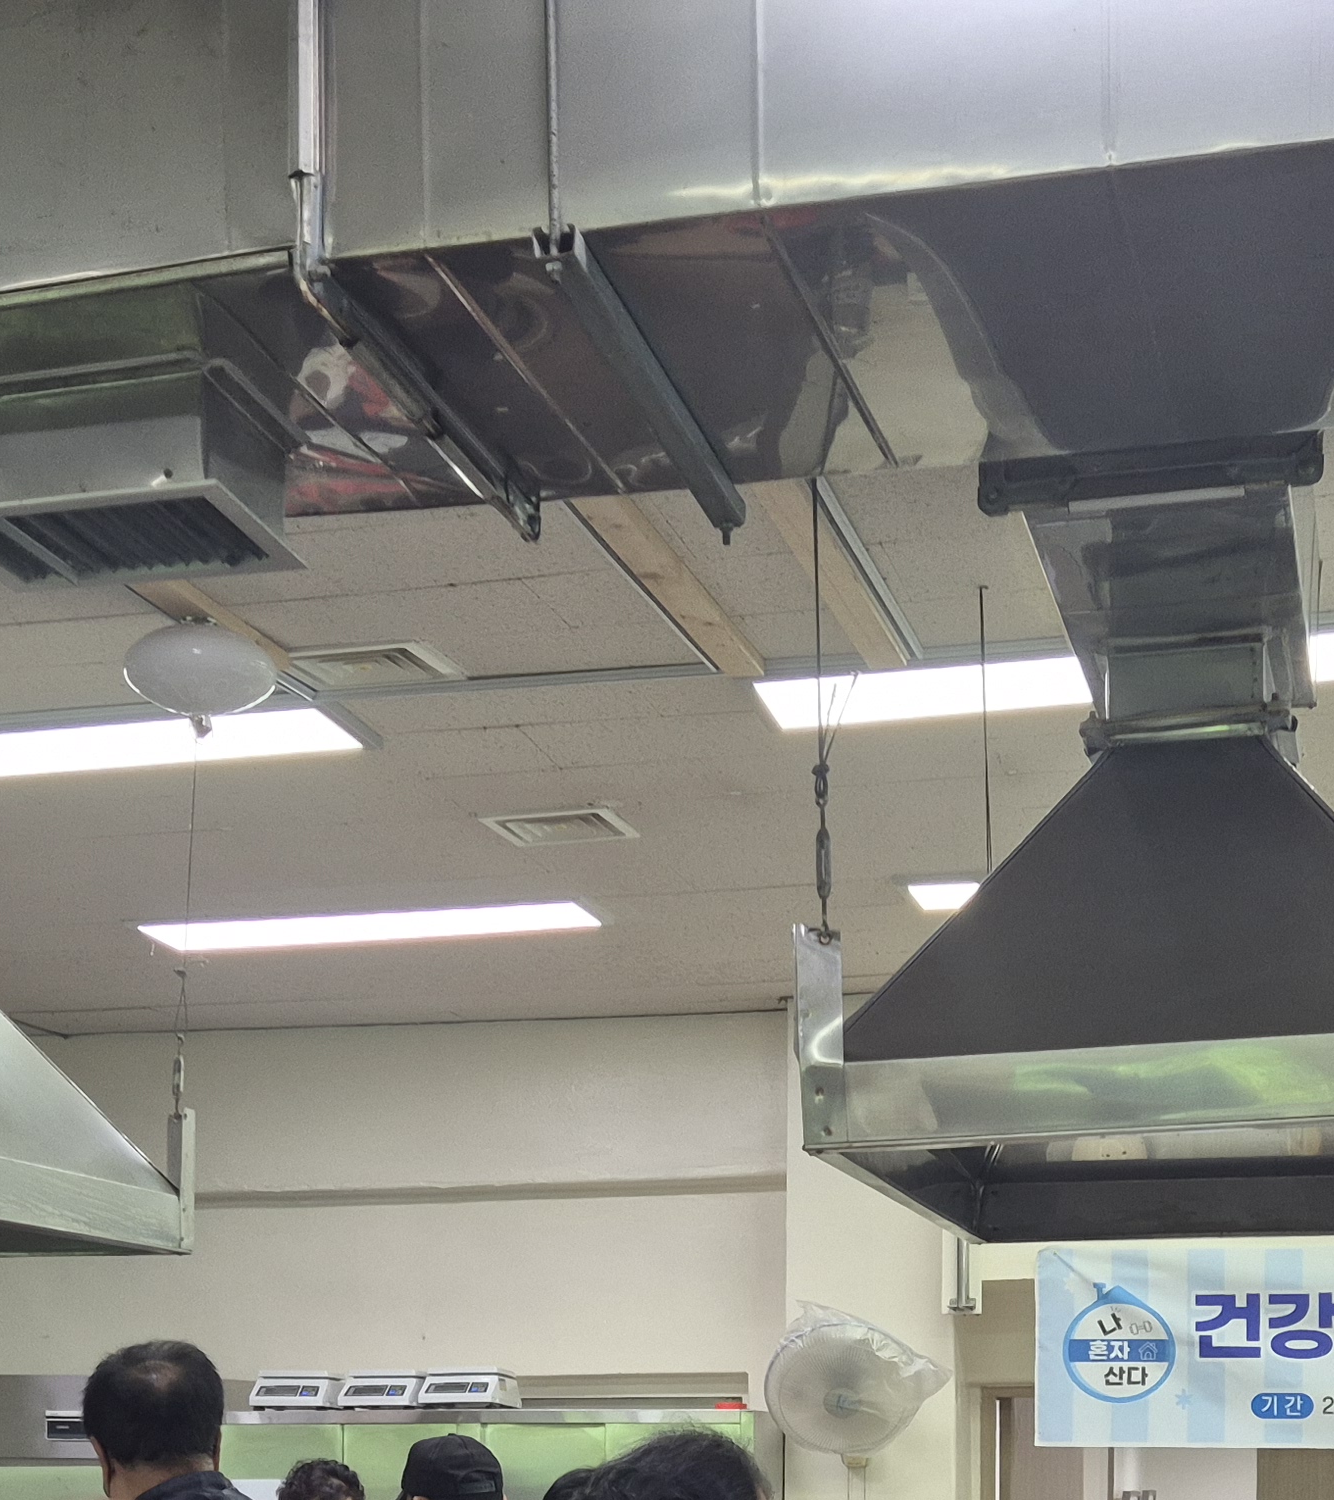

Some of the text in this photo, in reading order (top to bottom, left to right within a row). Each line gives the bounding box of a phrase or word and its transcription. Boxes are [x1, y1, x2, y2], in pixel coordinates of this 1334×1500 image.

[1097, 1312, 1123, 1337] 나
[1087, 1339, 1131, 1361] 혼자
[1103, 1366, 1149, 1386] 산다
